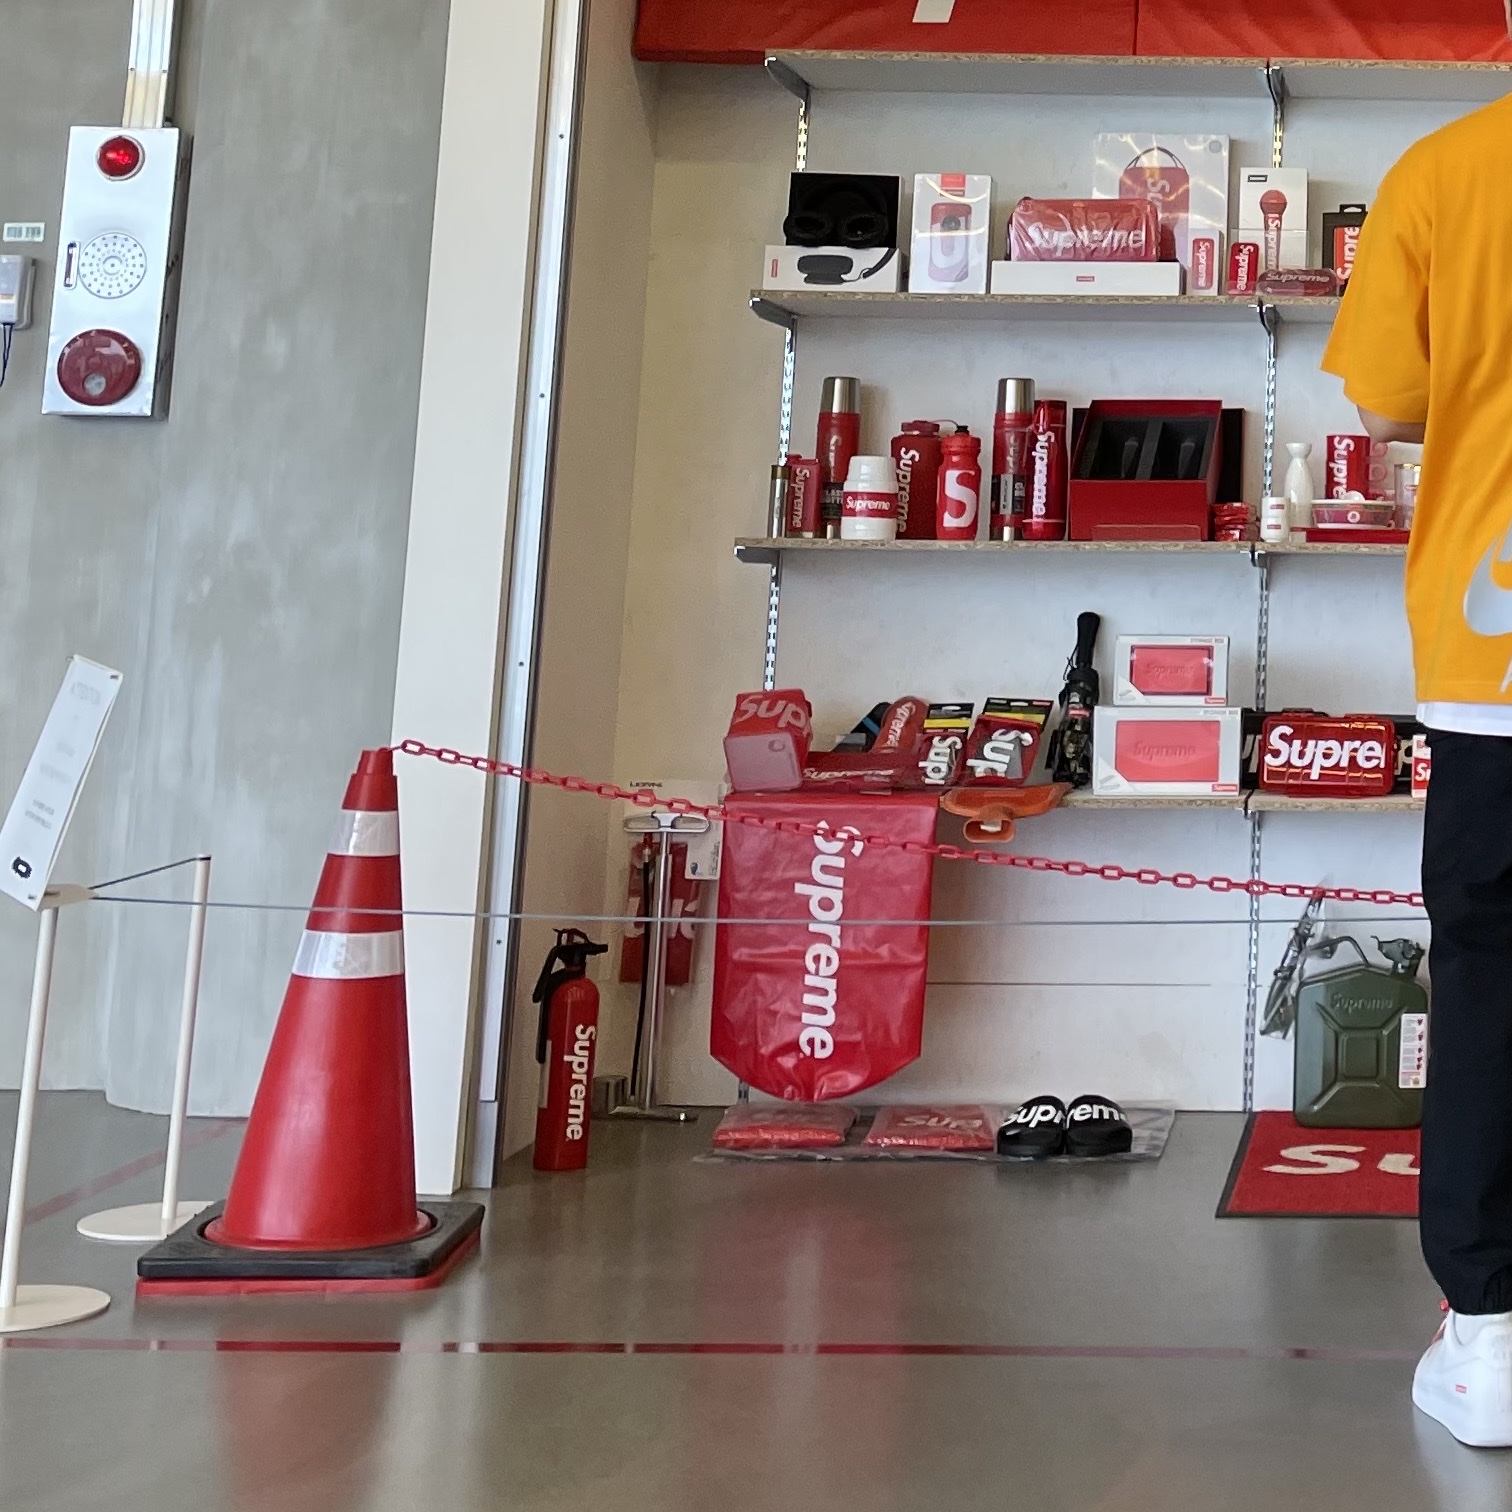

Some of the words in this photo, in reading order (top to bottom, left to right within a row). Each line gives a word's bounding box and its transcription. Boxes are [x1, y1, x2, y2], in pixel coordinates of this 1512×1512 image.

[791, 467, 810, 528] Supreme
[845, 496, 891, 511] Supreme
[895, 447, 920, 533] Supreme
[943, 469, 977, 528] S
[794, 818, 864, 1060] Supreme
[565, 1023, 597, 1143] Supreme
